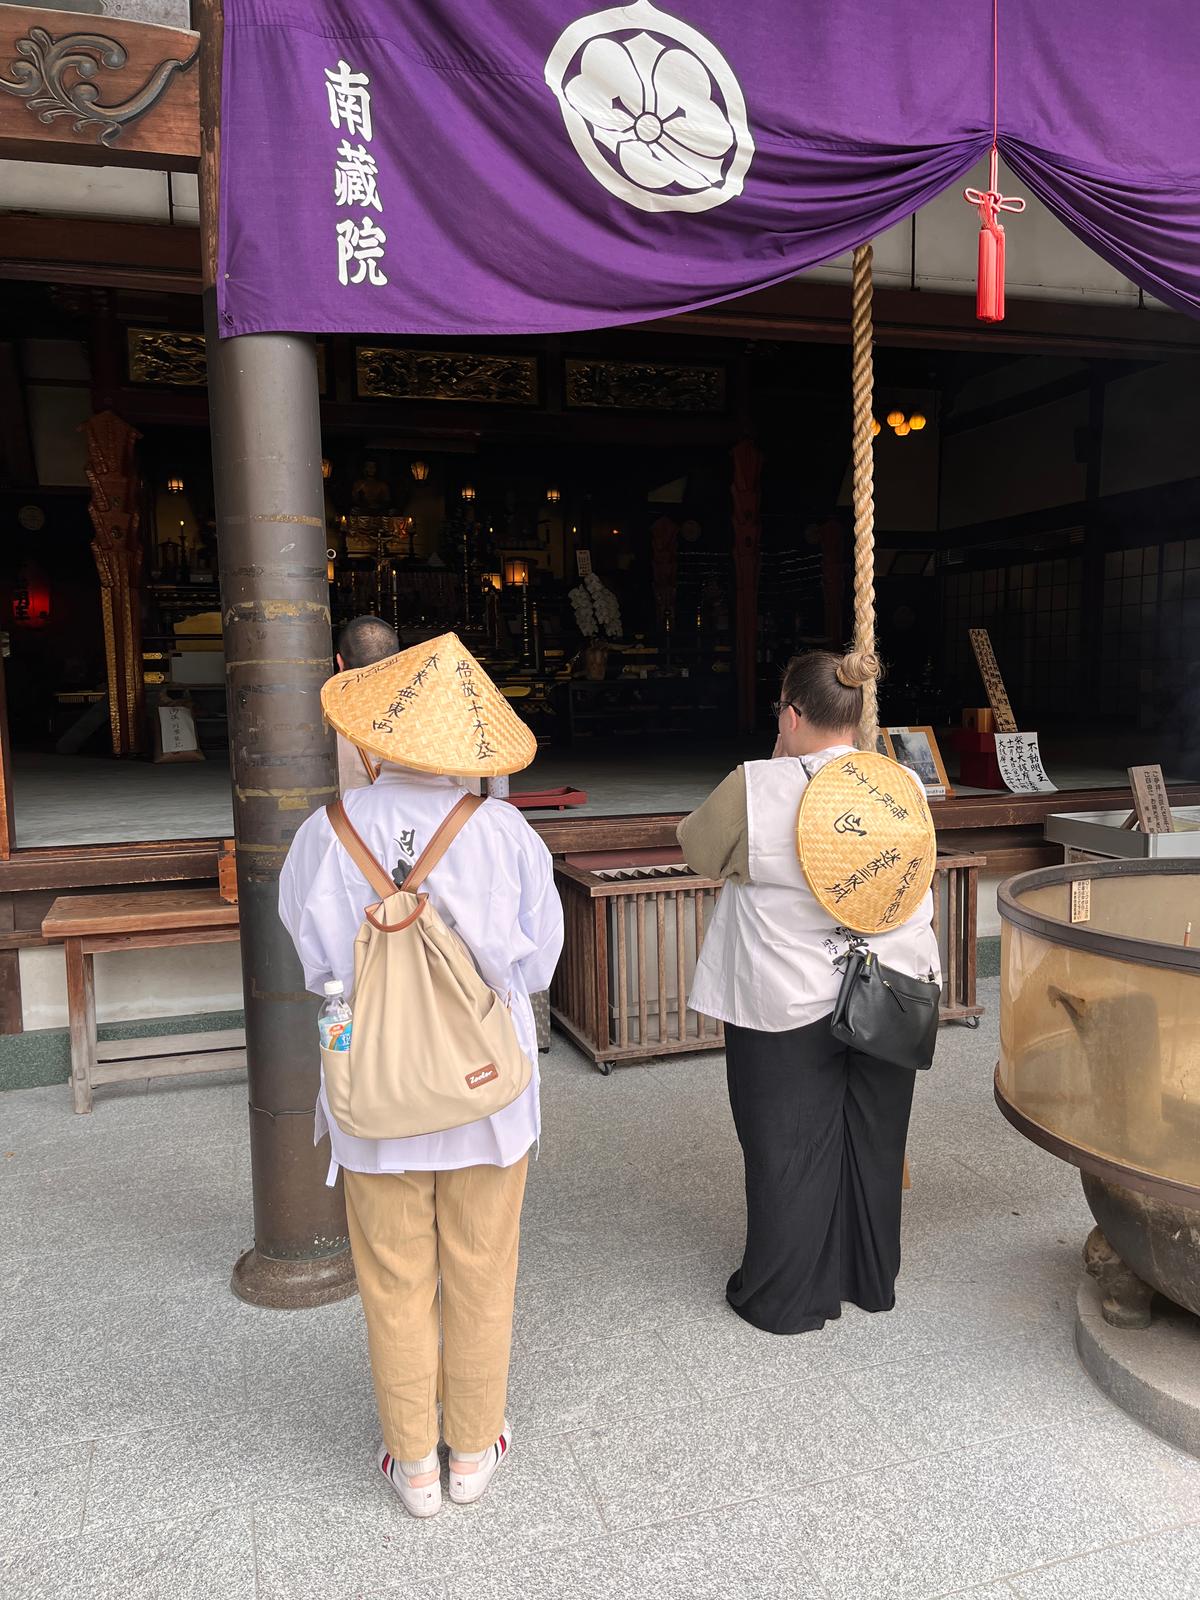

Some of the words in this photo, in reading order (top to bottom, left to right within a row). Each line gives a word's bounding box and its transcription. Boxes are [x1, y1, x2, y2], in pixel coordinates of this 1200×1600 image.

[455, 659, 498, 760] 悟故十方空
[1027, 742, 1048, 782] 不動明王
